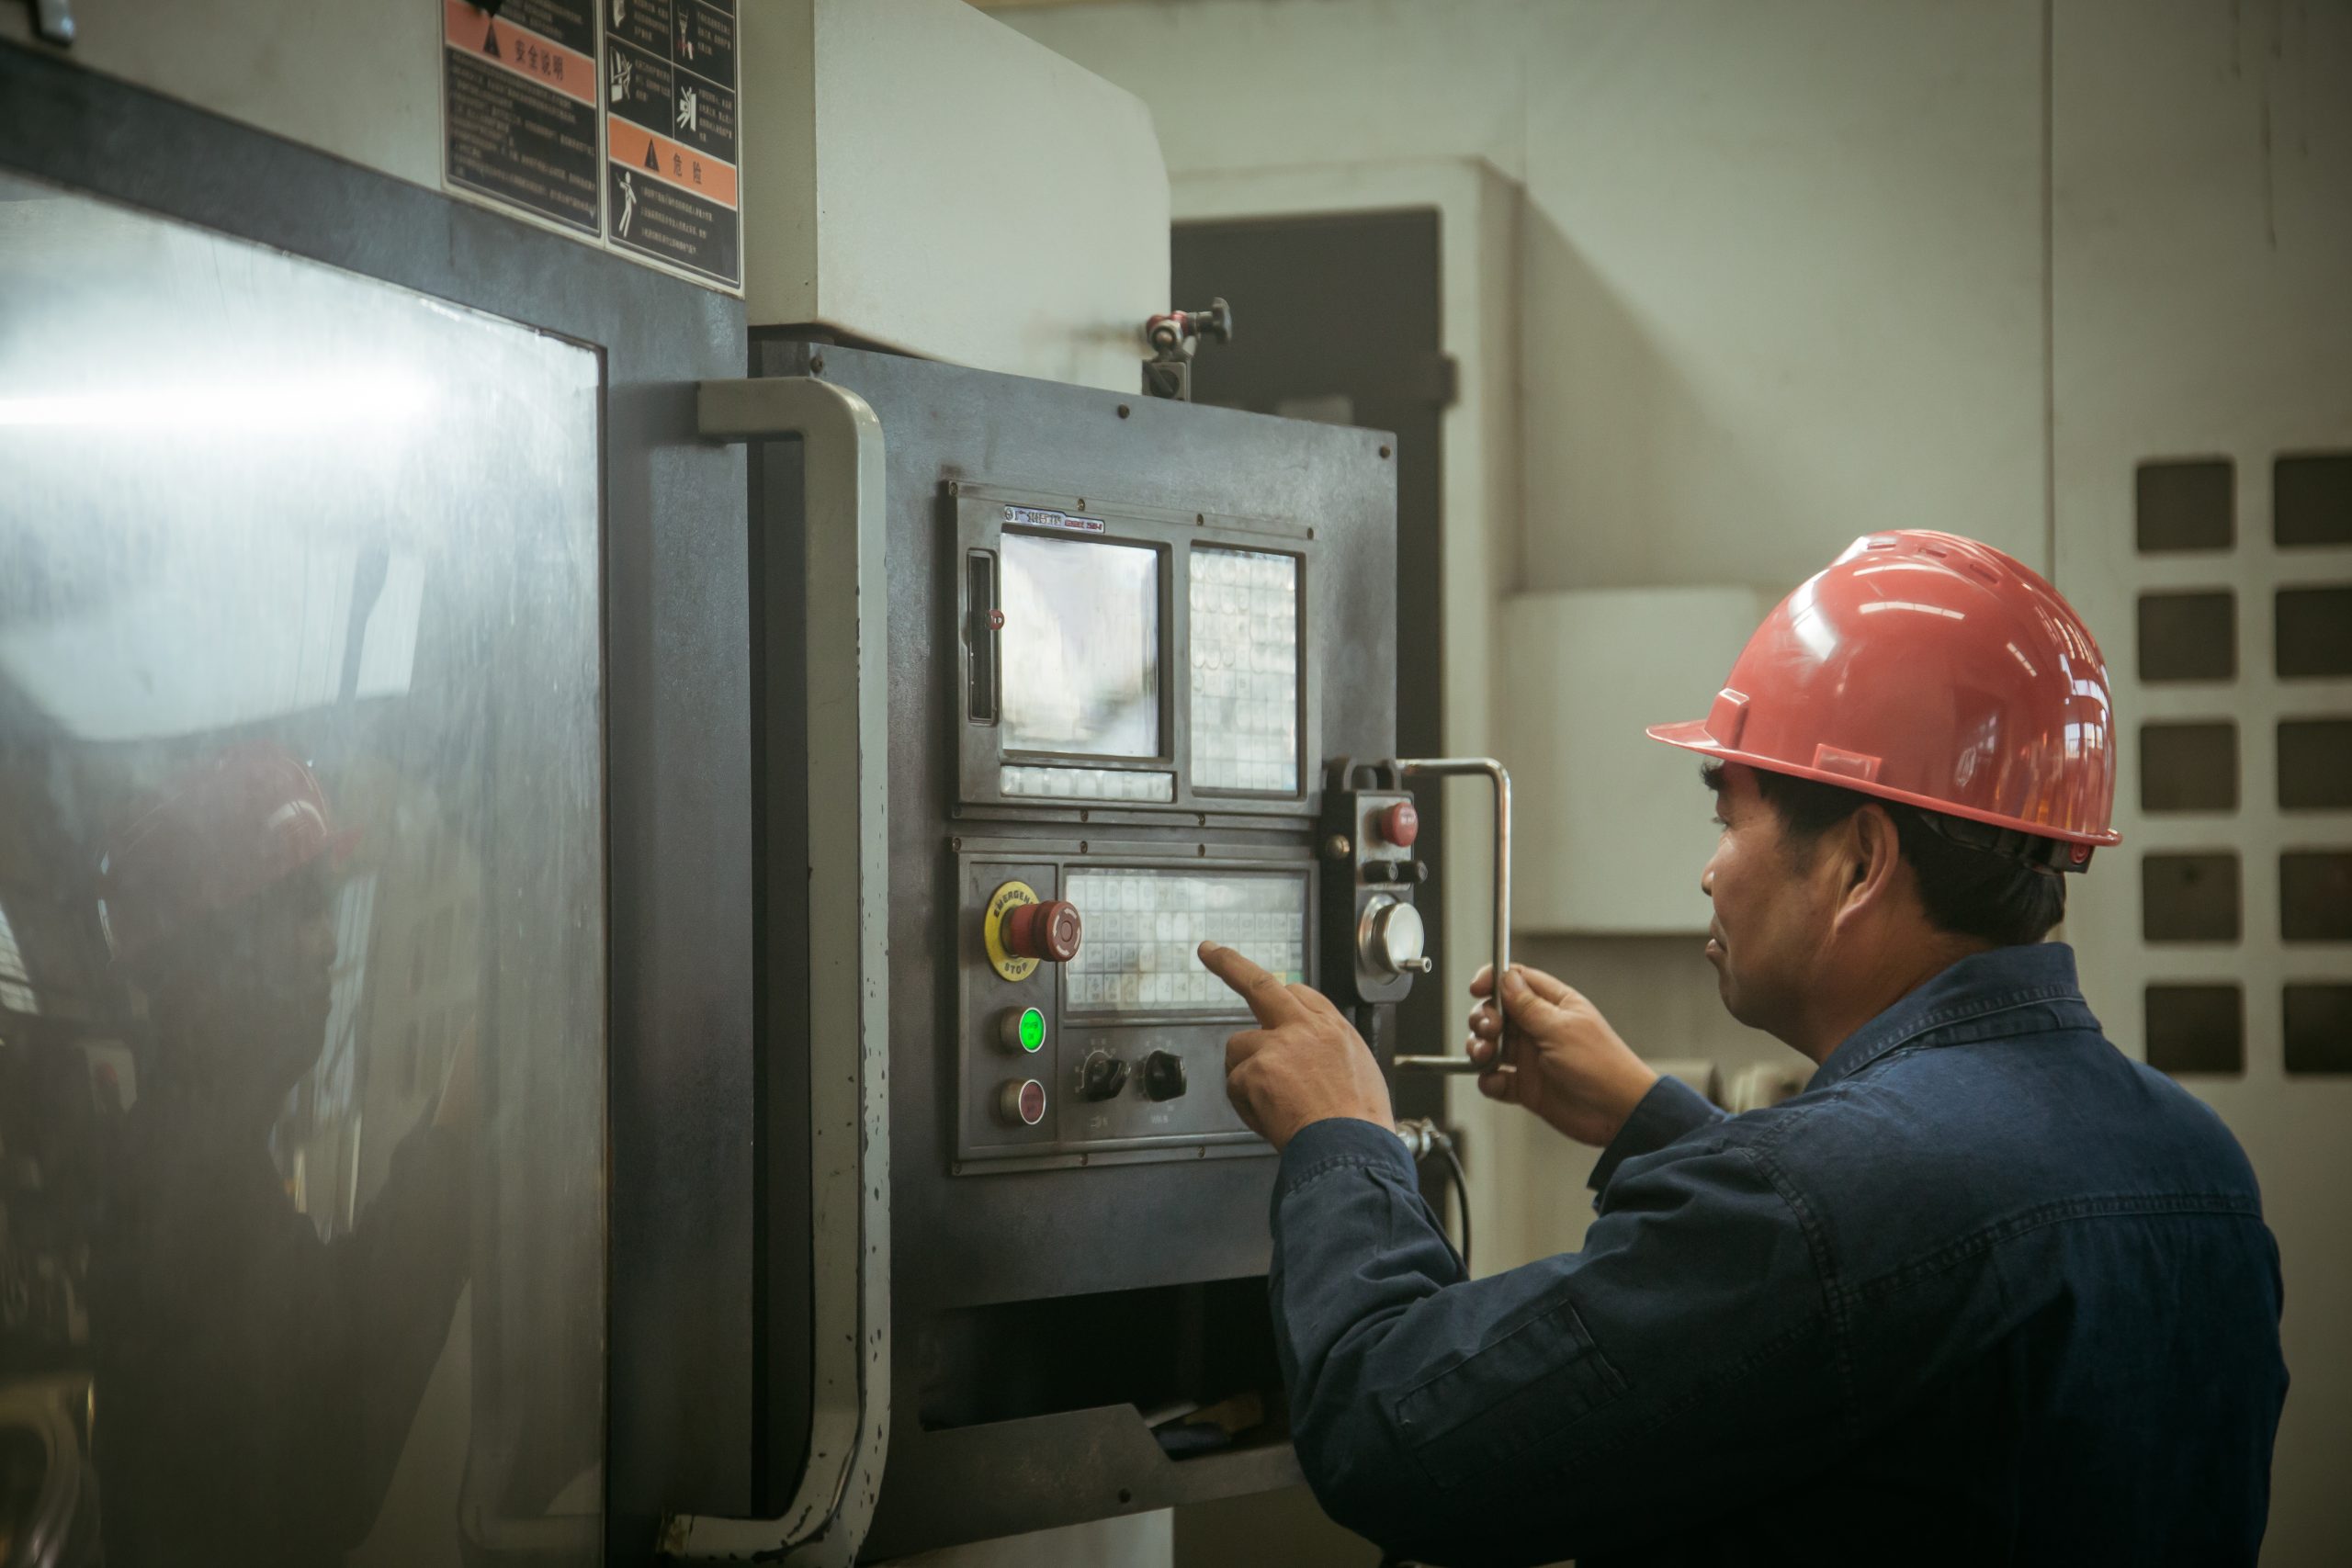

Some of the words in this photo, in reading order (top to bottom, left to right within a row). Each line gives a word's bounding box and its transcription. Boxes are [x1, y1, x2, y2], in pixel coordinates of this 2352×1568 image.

[515, 39, 564, 82] 安全说明
[993, 890, 1034, 919] EMERGEN
[1004, 961, 1028, 975] STOP
